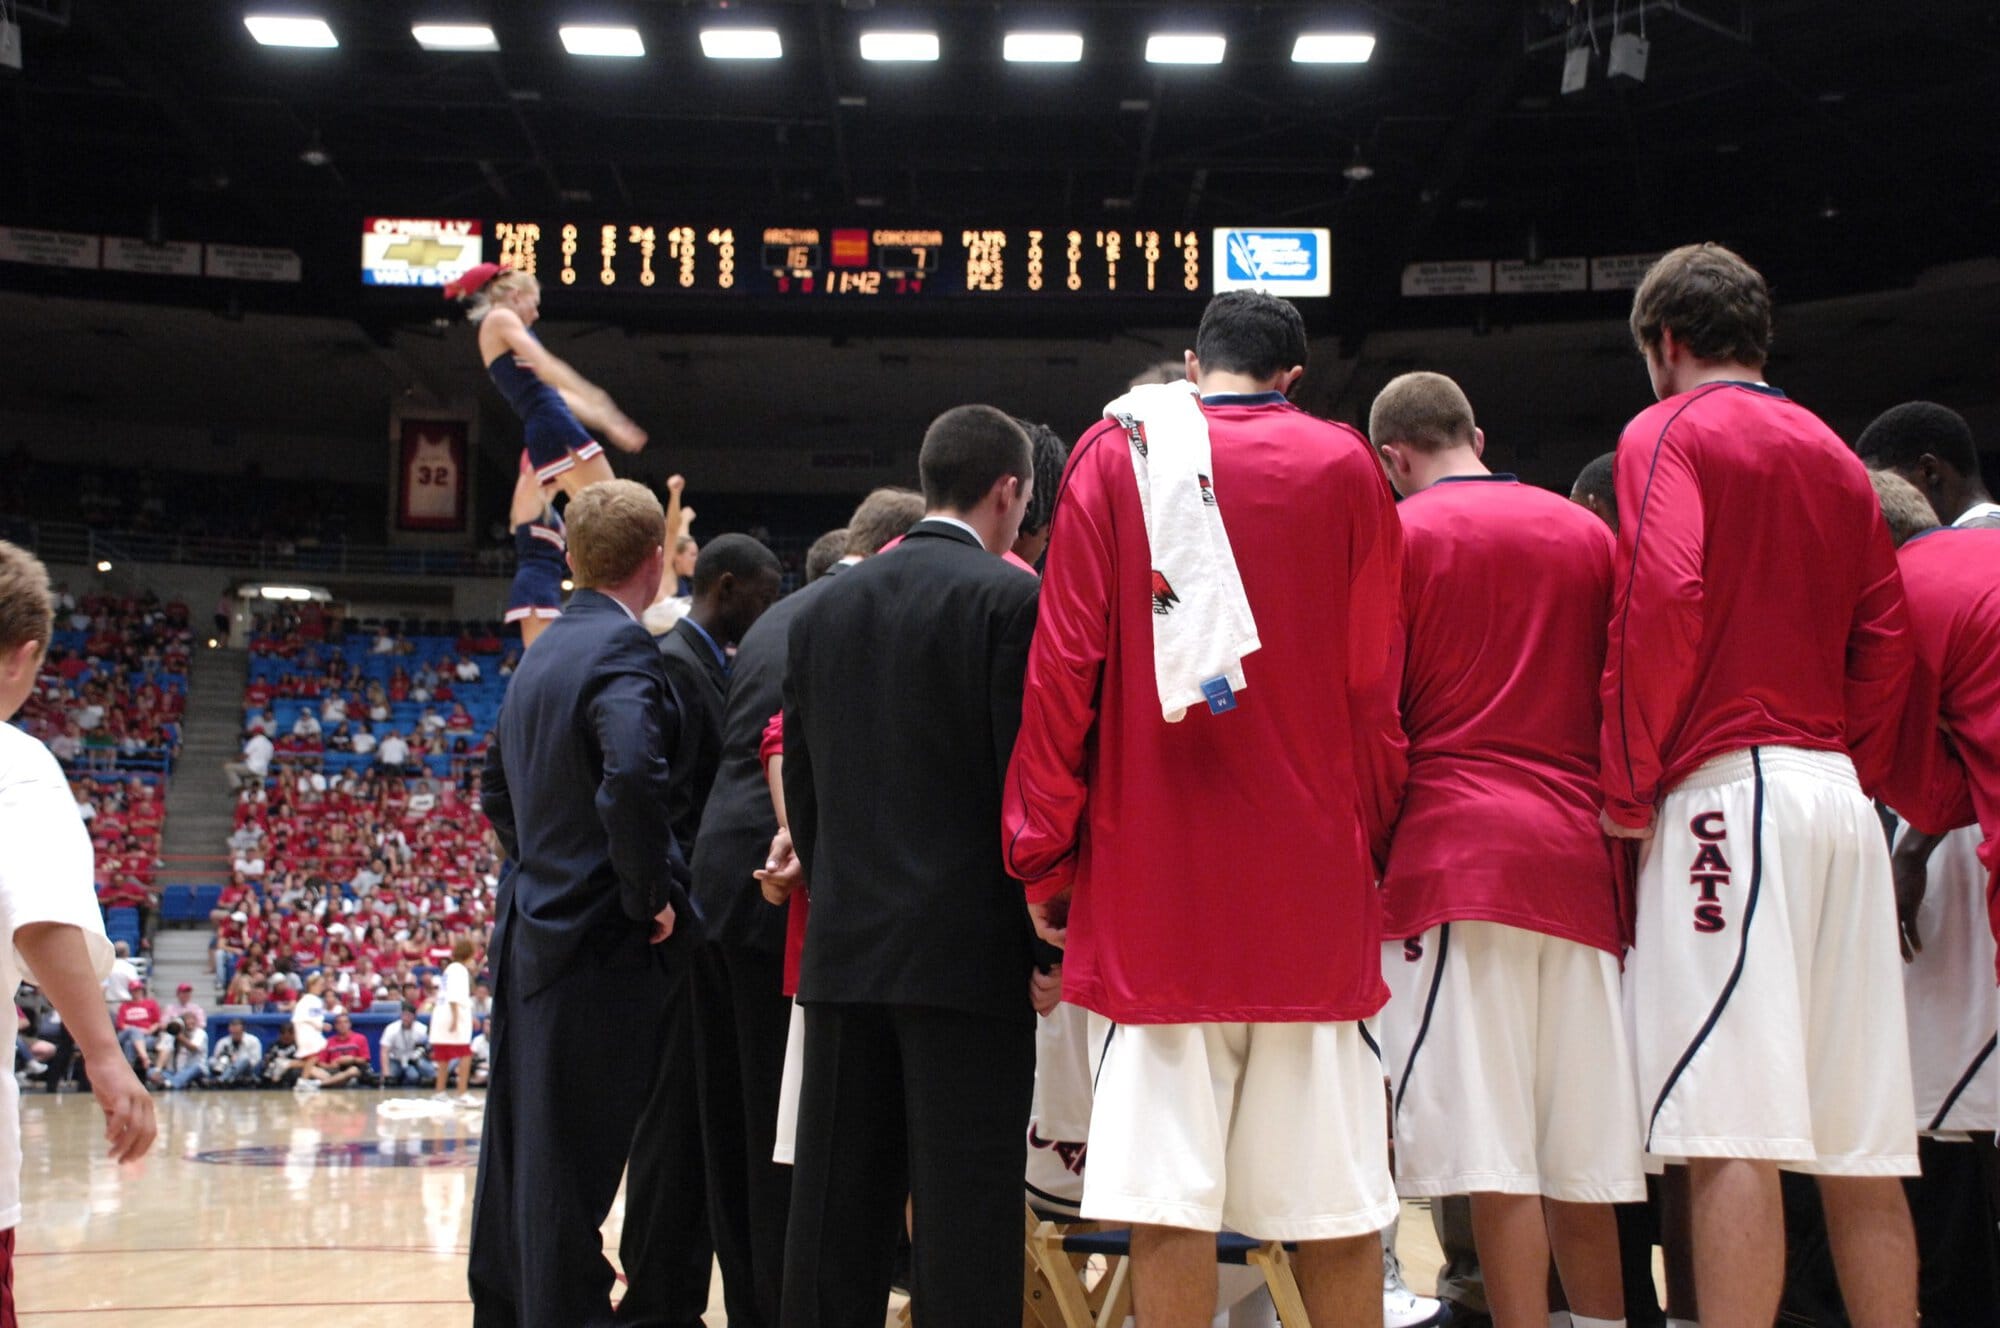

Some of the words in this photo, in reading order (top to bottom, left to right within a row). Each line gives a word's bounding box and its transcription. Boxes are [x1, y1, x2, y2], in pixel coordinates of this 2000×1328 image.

[911, 248, 926, 269] 7
[374, 268, 466, 283] WATSO
[826, 271, 880, 293] 11:42
[418, 465, 448, 486] 32
[1690, 810, 1731, 934] CATS
